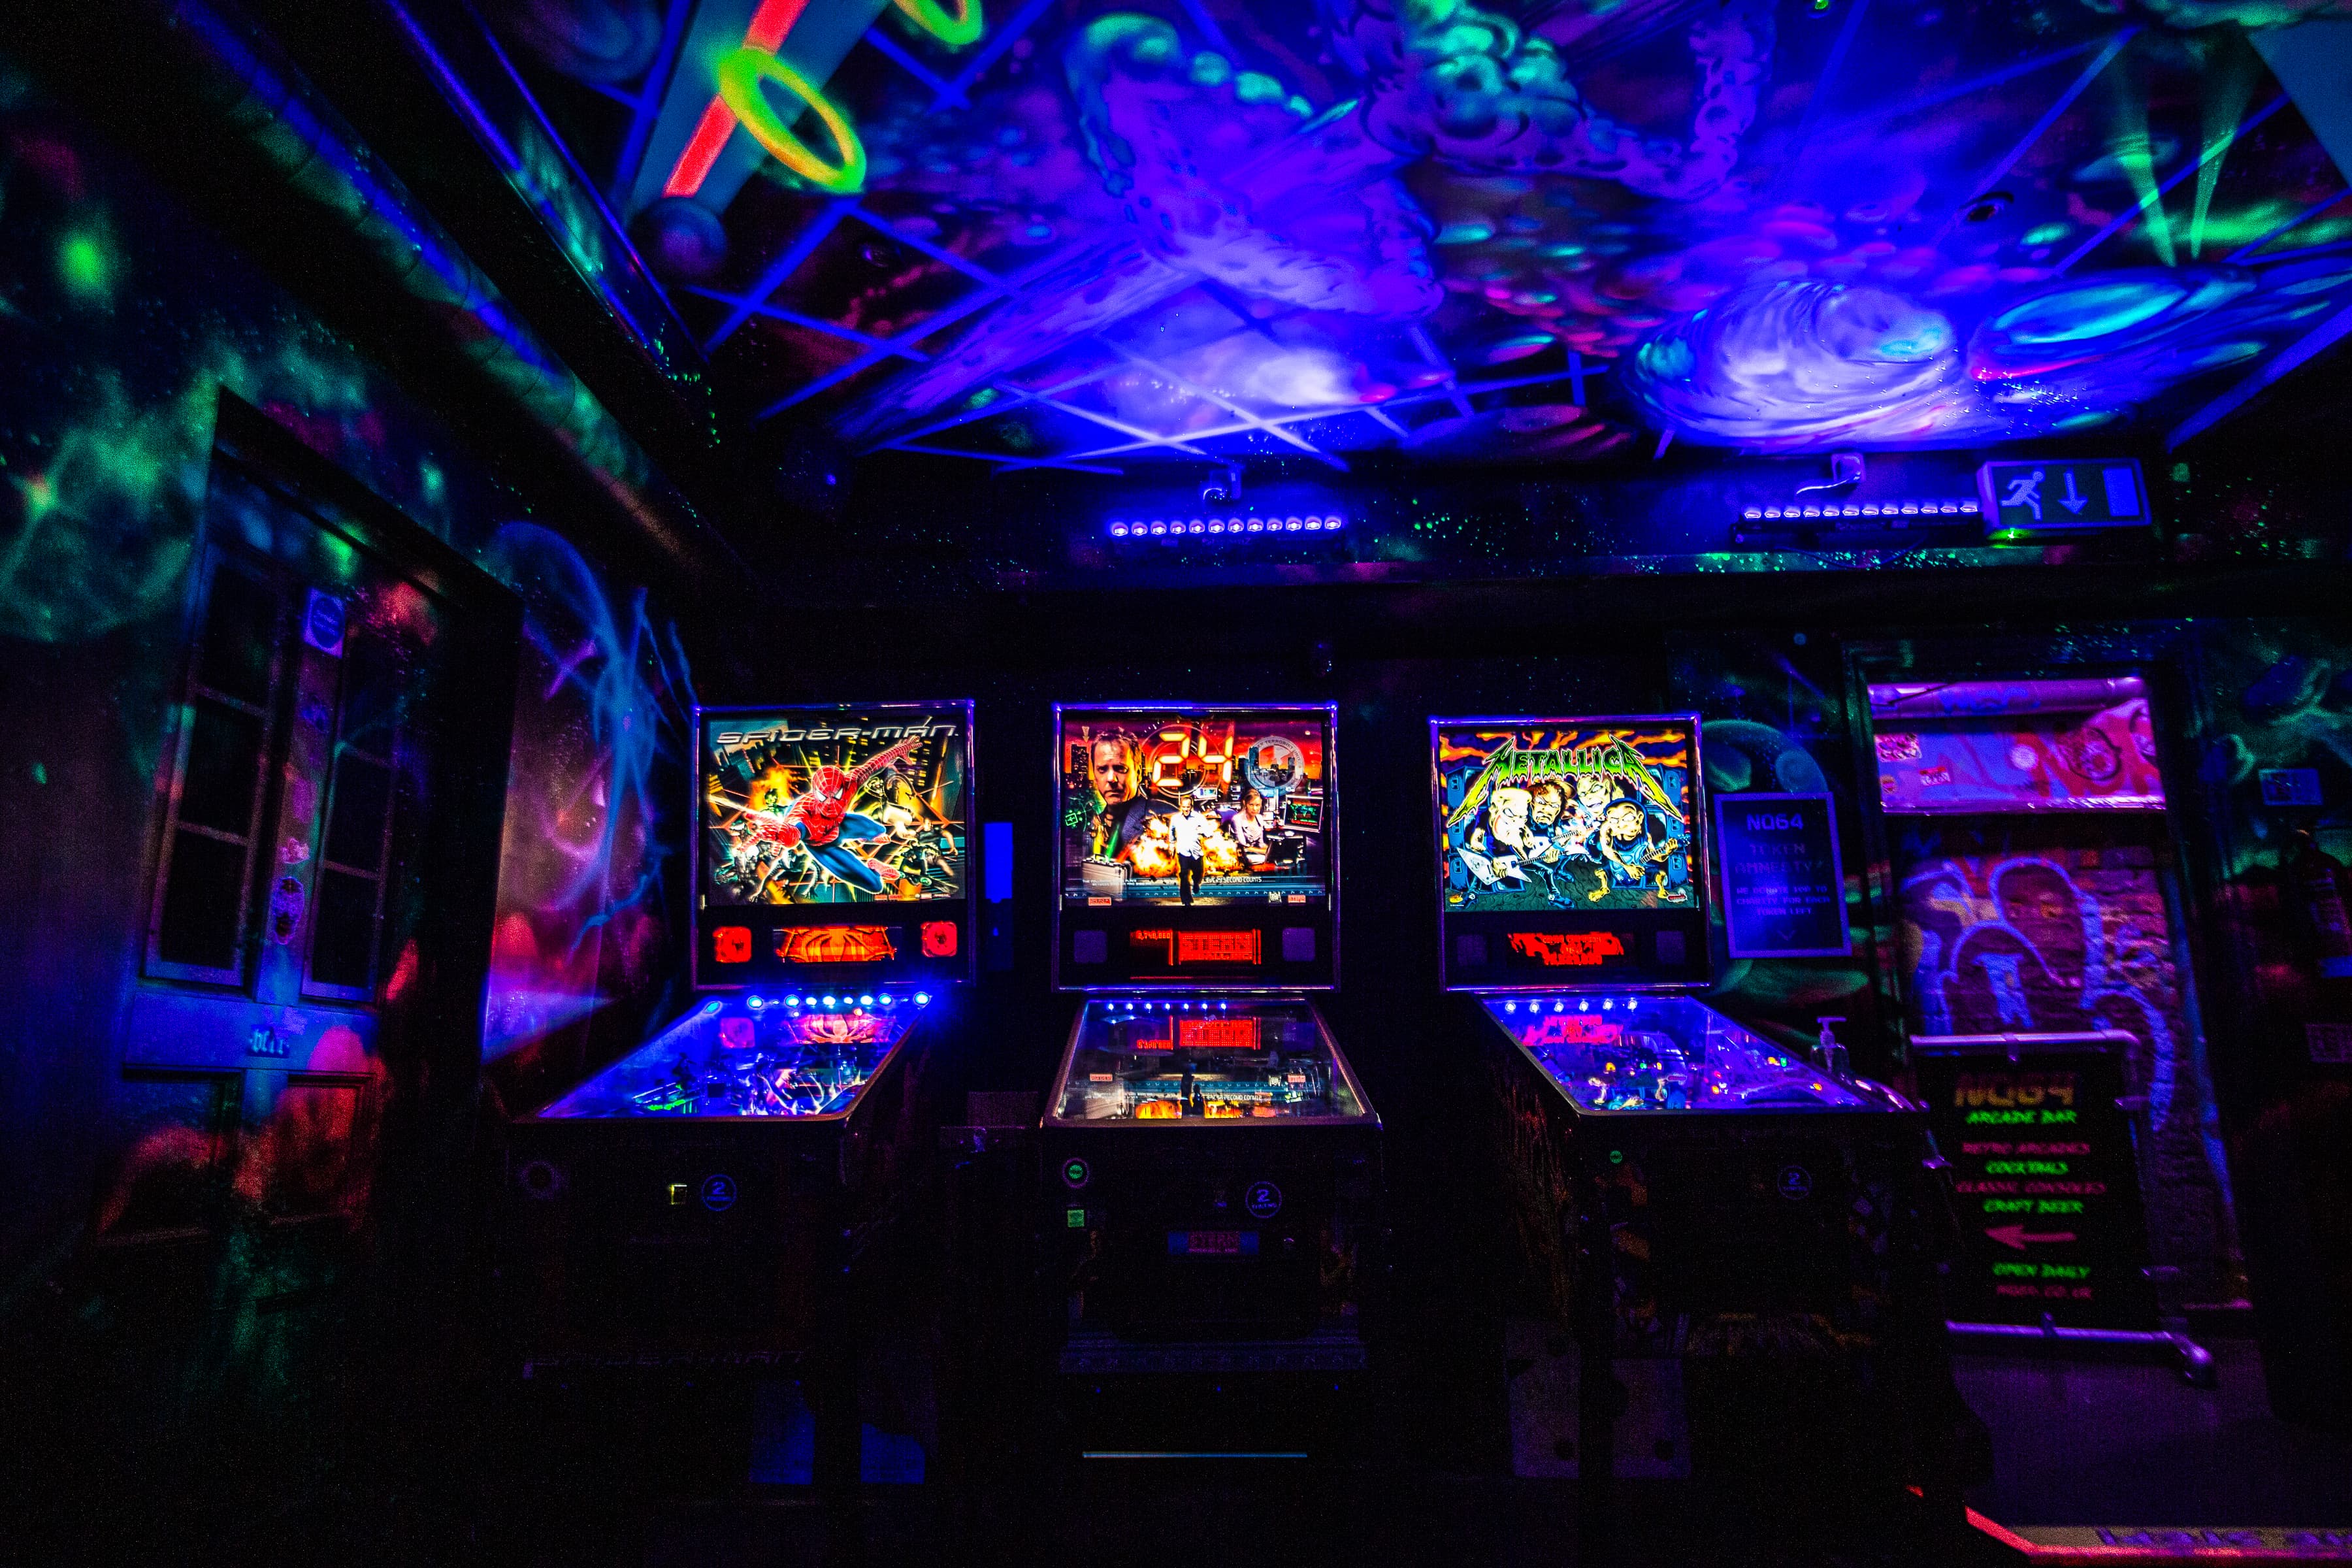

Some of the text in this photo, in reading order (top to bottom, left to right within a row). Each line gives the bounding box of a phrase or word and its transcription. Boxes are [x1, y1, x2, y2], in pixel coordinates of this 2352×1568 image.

[717, 724, 957, 743] SPIDER-MAN
[1152, 732, 1234, 787] 24
[1746, 813, 1804, 831] NQ64
[1965, 1110, 2078, 1124] ARCADE BAR
[1985, 1160, 2069, 1175] COCKTAILS
[1788, 1172, 1801, 1186] 2
[711, 1181, 727, 1195] 2
[1256, 1189, 1270, 1203] 2
[1982, 1198, 2083, 1214] CRAFT BEER
[1993, 1262, 2091, 1279] OPEN DAILY
